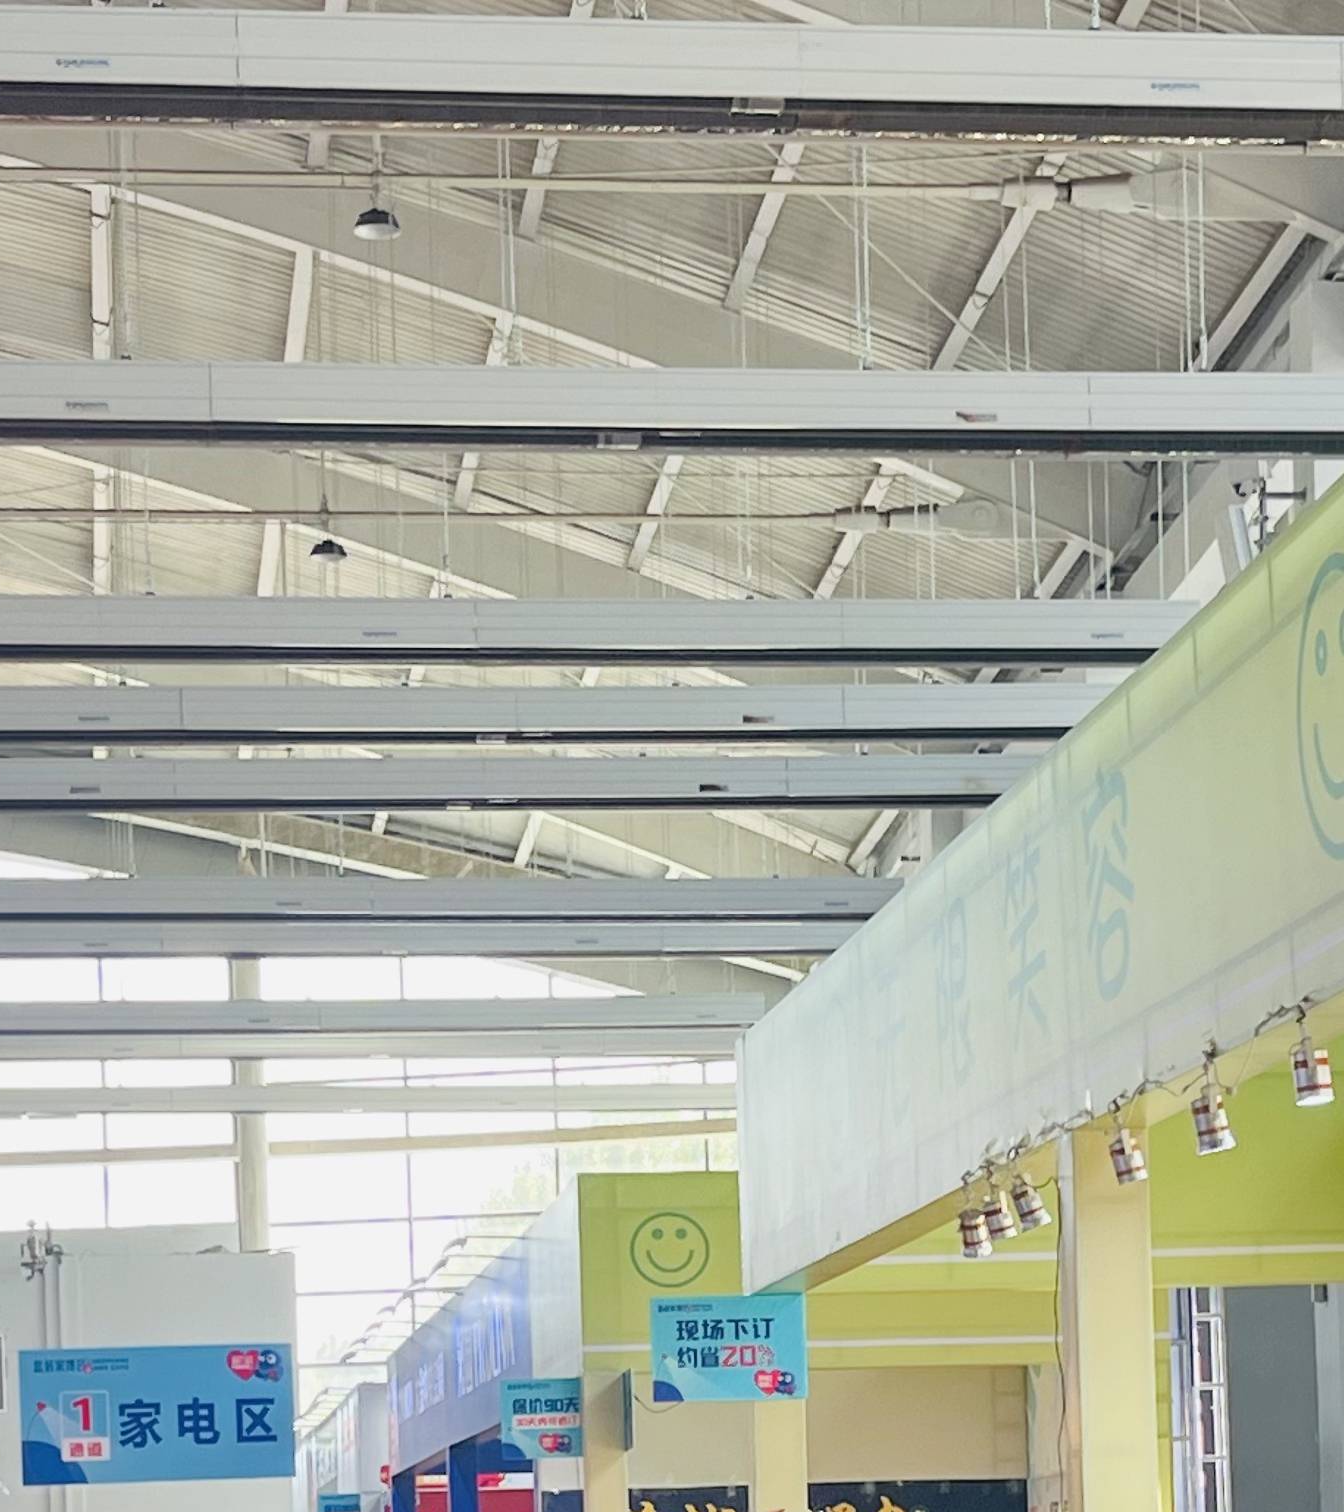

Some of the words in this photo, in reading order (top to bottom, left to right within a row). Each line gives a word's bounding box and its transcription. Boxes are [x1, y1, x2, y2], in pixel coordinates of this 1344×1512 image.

[676, 1318, 775, 1342] 现场下订
[677, 1344, 776, 1369] 约省20%
[72, 1397, 91, 1432] 1
[118, 1396, 279, 1449] 家电区
[70, 1442, 103, 1458] 通道
